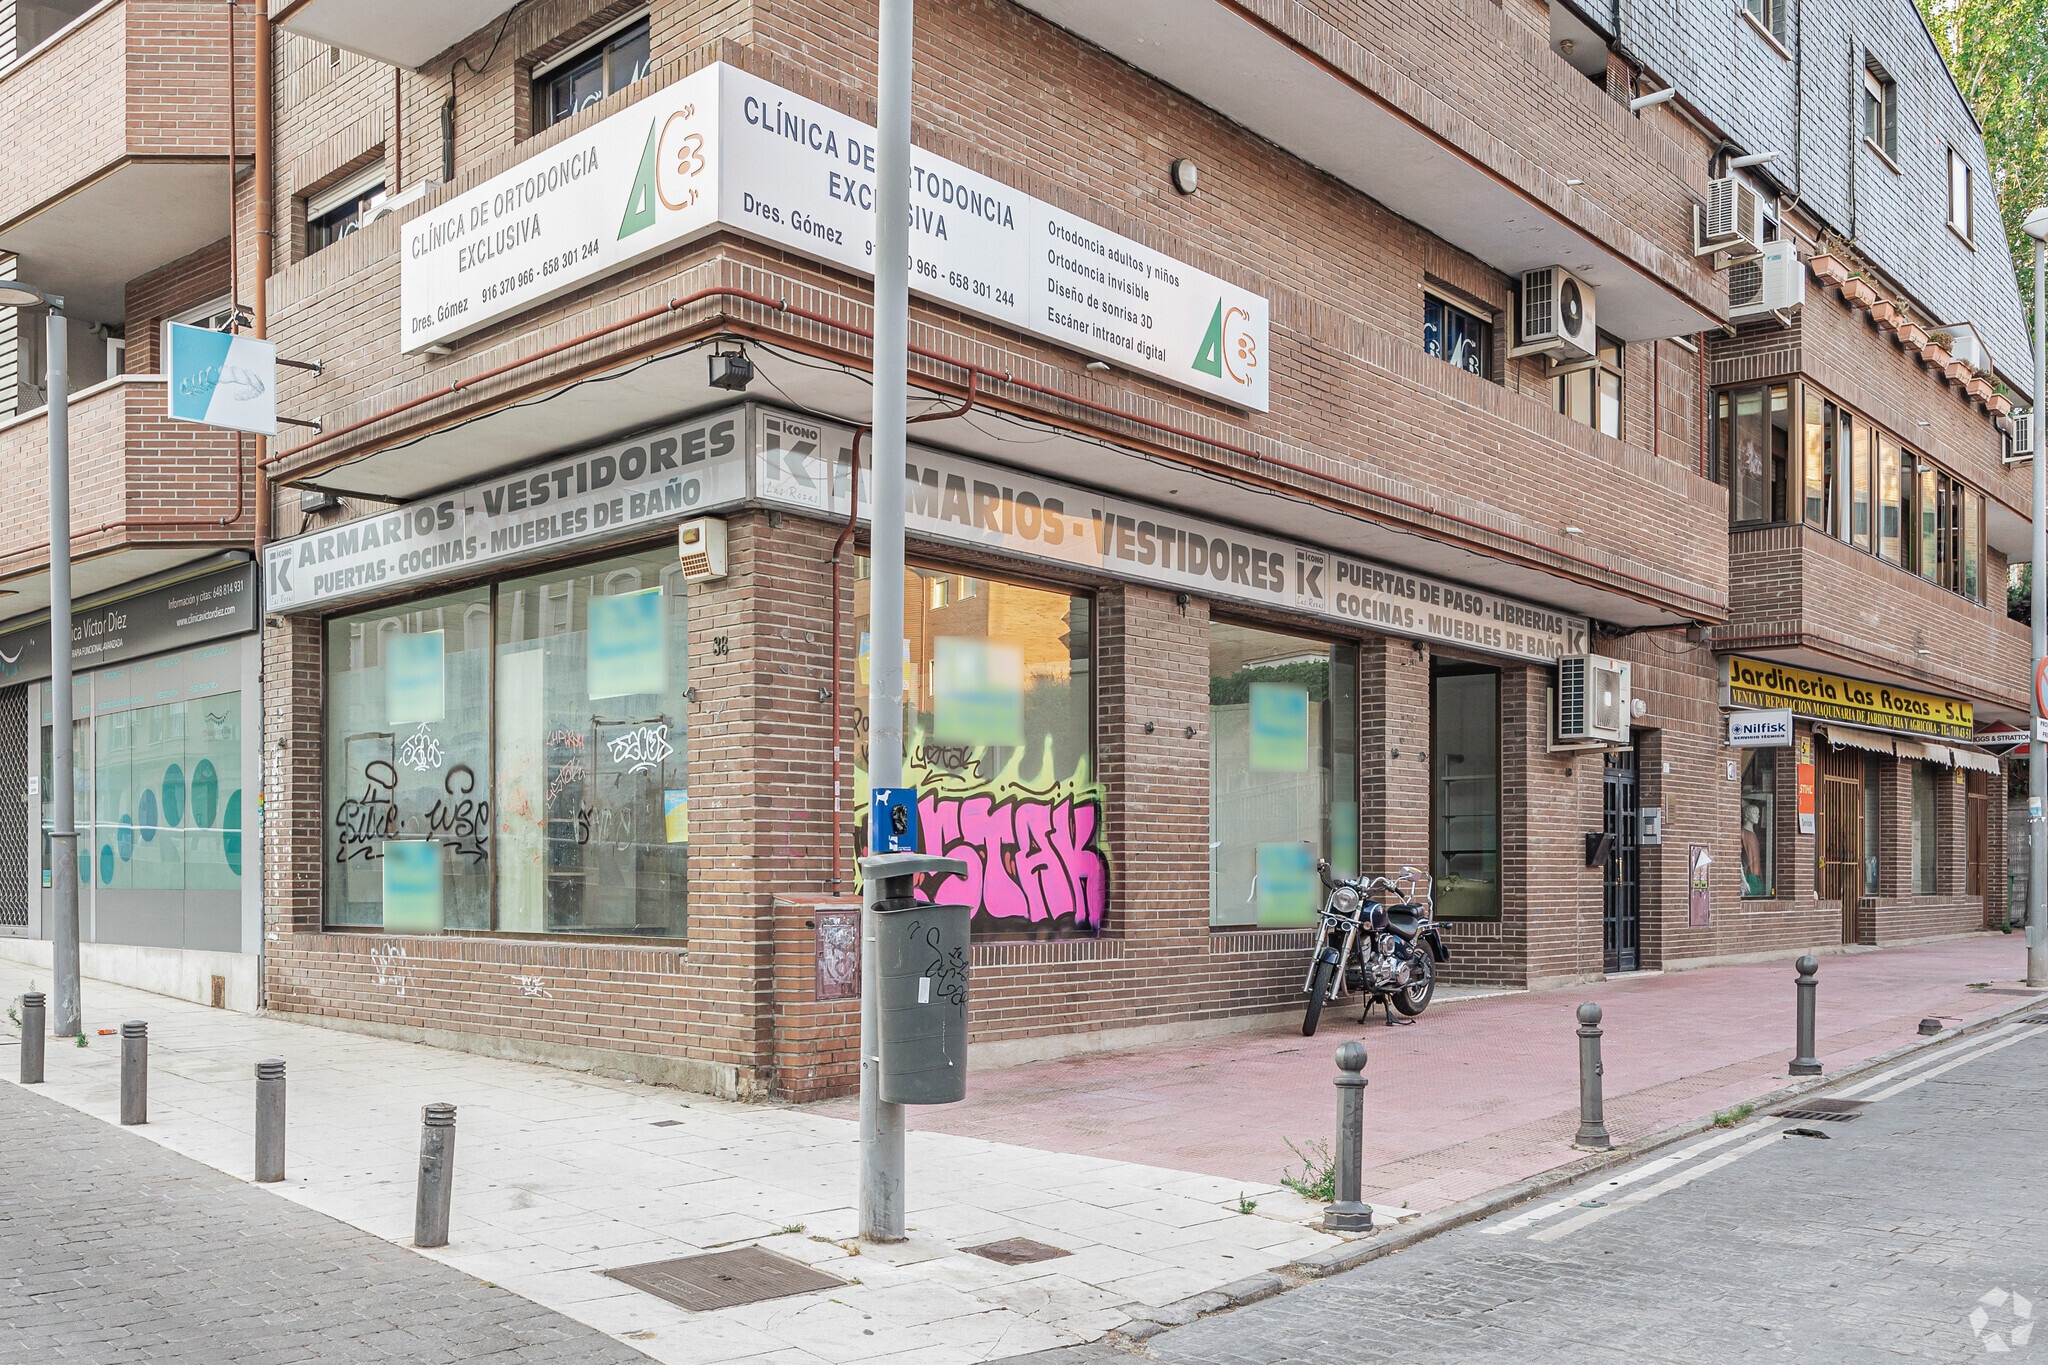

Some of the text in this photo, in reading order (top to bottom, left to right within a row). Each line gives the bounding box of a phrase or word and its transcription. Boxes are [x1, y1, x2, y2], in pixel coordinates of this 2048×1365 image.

[744, 96, 1015, 231] CLÍNICA DE TODONCIA
[411, 145, 599, 260] CLÍNICA DE ORTODONCIA
[829, 171, 948, 241] EXCIVA
[459, 213, 541, 273] EXCLUSIVA
[743, 192, 785, 226] Dres.
[791, 210, 843, 246] Gómez
[916, 259, 938, 281] 966
[949, 269, 969, 291] 658
[973, 280, 991, 300] 301
[995, 288, 1015, 308] 244
[1048, 220, 1180, 288] Ortodoncia adultos y niños
[1048, 249, 1149, 302] Ortodoncia invisible
[412, 310, 435, 334] Dres.
[437, 297, 468, 322] Gómez
[482, 283, 498, 304] 916
[500, 275, 516, 296] 370
[518, 267, 534, 288] 966
[542, 258, 559, 277] 658
[562, 249, 578, 269] 301
[582, 238, 599, 260] 244
[1048, 278, 1153, 330] Diseño de sonrisa 3D
[1048, 306, 1166, 363] Escáner intraoral digital
[298, 500, 455, 569] ARMARIOS
[482, 419, 735, 518] VESTIDORES
[832, 446, 1064, 546] AMARIOS
[1091, 508, 1285, 593] VESTIDORES
[313, 558, 386, 596] PUERTAS
[398, 535, 477, 575] COCINAS
[490, 507, 588, 554] MUEBLES
[593, 497, 623, 529] DE
[630, 476, 700, 520] BAÑO
[108, 610, 127, 632] Díez
[168, 593, 195, 609] Información
[223, 582, 233, 596] 814
[233, 580, 244, 593] 931
[1336, 560, 1415, 600] PUERTAS
[1420, 581, 1440, 606] DE
[1443, 587, 1483, 616] PASO
[1493, 600, 1563, 635] LIBRERIAS
[1336, 592, 1414, 629] COCINAS
[1428, 613, 1502, 648] MUEBLES
[1506, 630, 1523, 652] DE
[1526, 633, 1564, 659] BAÑO
[1730, 660, 1837, 700] Jardineria
[1843, 681, 1874, 706] Las
[1880, 689, 1930, 716] Rozas
[1945, 702, 1971, 724] S.L.
[1732, 689, 1758, 706] VENTA
[1758, 693, 1764, 707] Y
[1765, 695, 1812, 715] REPARACION
[1813, 702, 1856, 721] MAQUINARIA
[1856, 712, 1866, 723] DE
[1904, 719, 1909, 730] Y
[1909, 719, 1937, 733] AGRICOLA
[1743, 722, 1786, 734] Nilfisk
